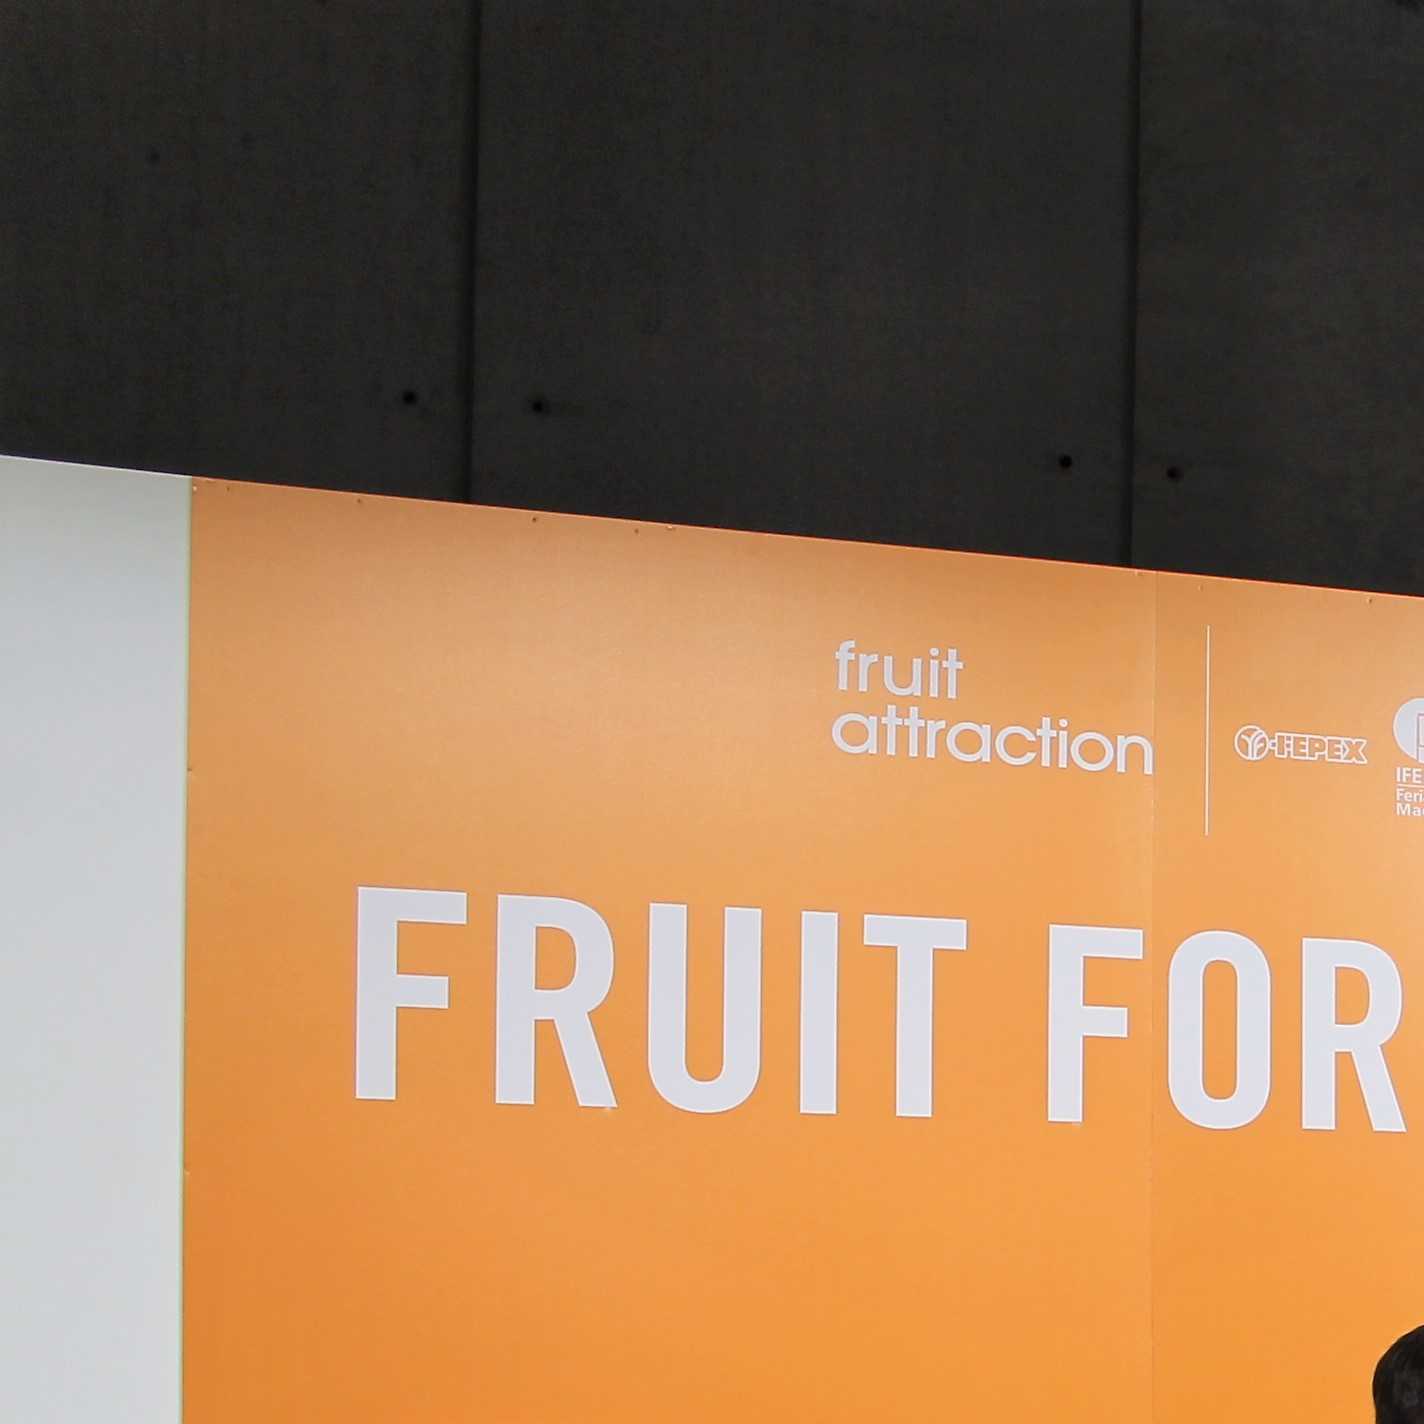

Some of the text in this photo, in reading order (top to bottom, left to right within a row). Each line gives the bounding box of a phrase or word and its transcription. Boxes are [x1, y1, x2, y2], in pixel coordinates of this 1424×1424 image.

[835, 640, 964, 699] fruit
[831, 704, 1154, 775] attraction
[355, 886, 968, 1118] FRUIT
